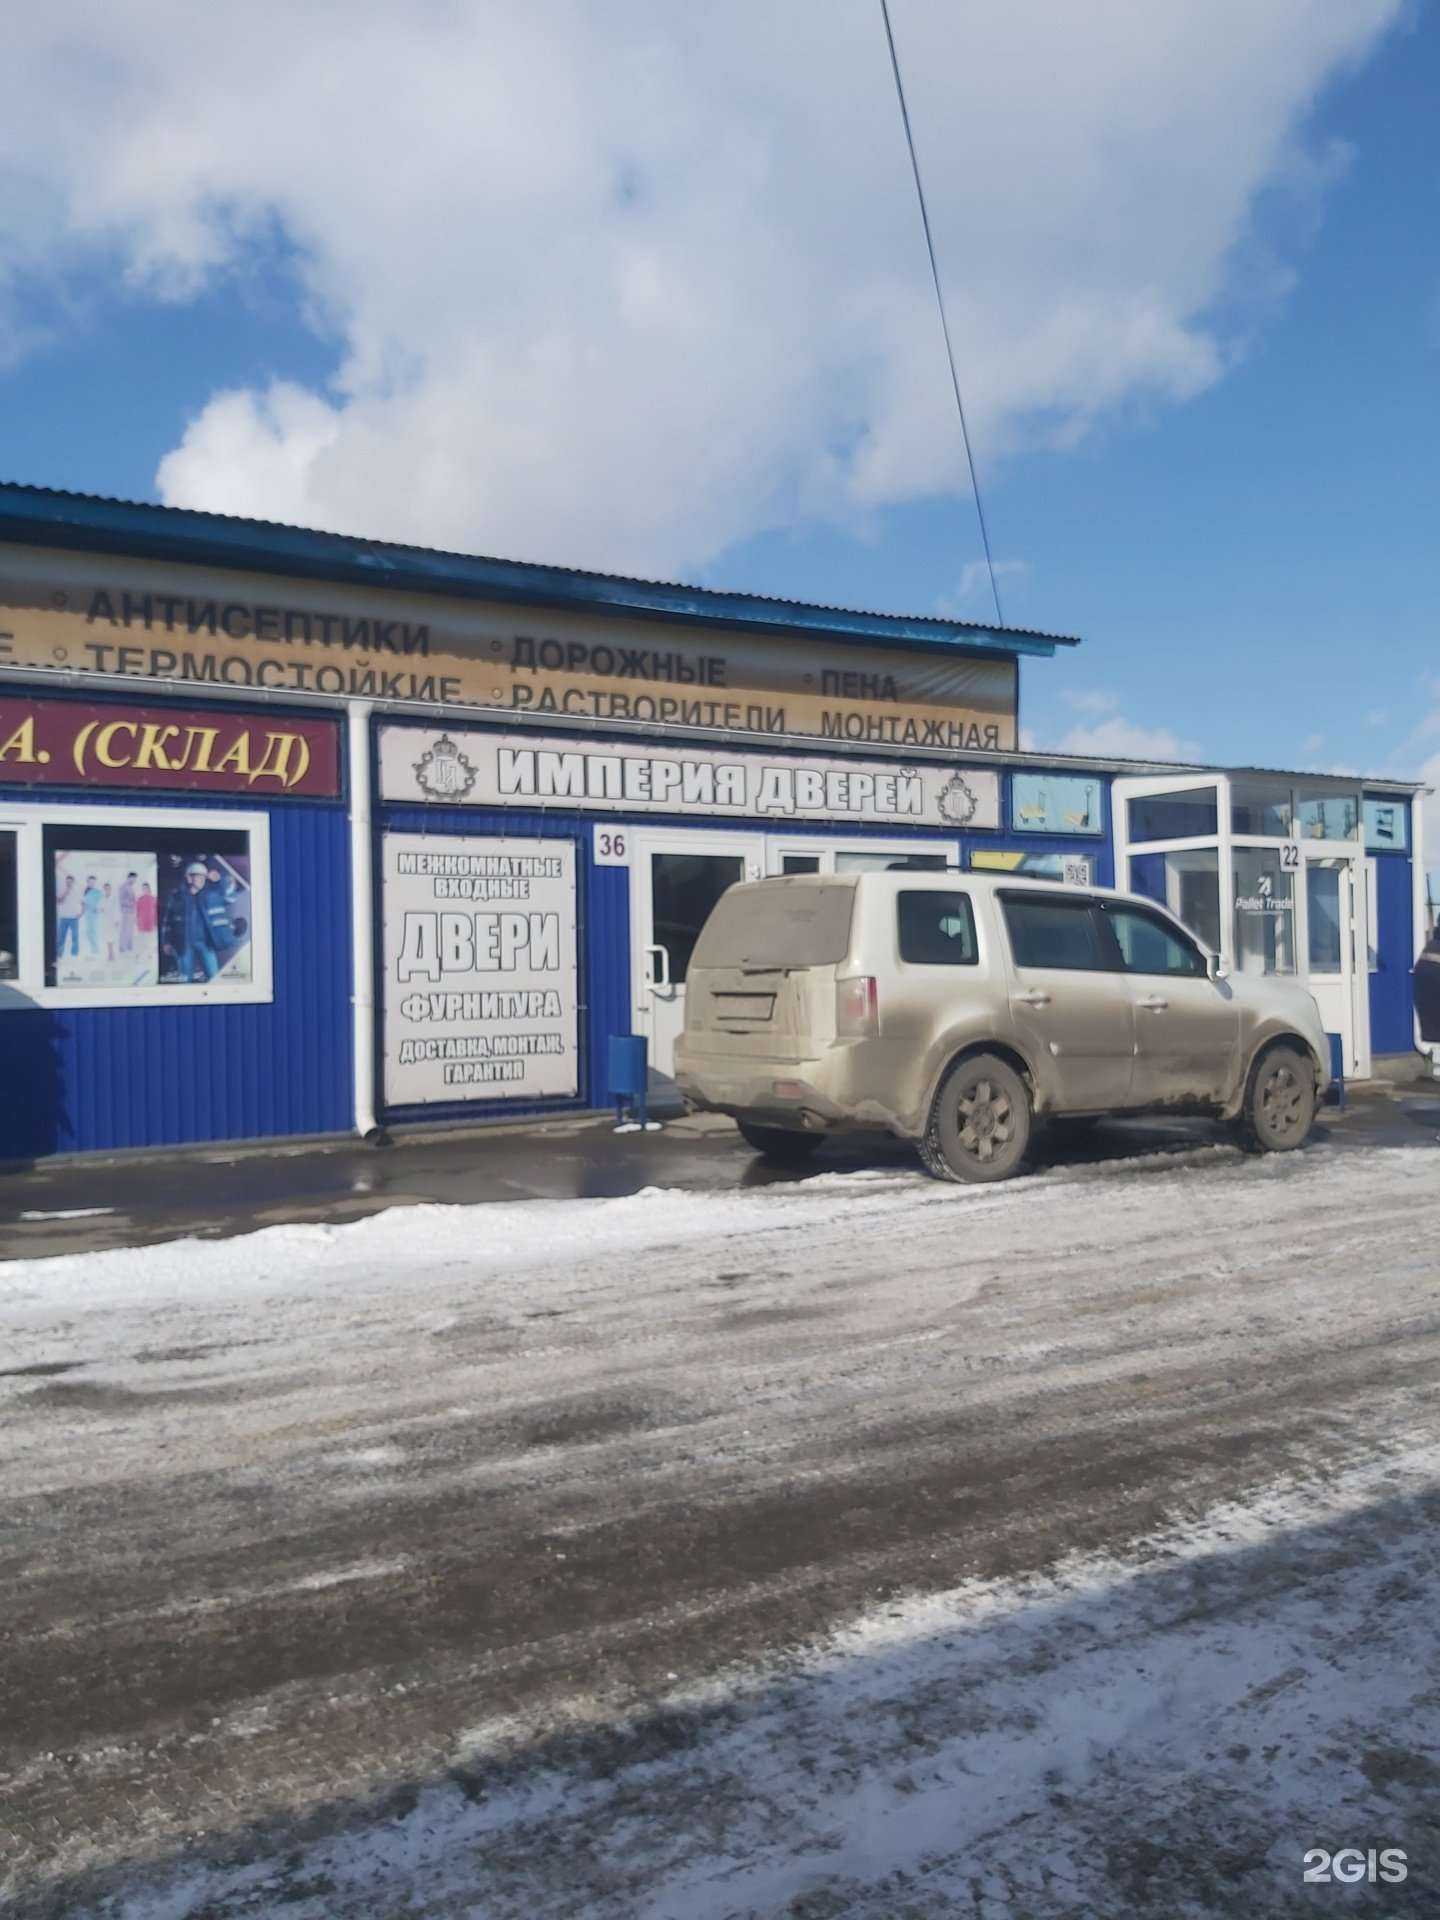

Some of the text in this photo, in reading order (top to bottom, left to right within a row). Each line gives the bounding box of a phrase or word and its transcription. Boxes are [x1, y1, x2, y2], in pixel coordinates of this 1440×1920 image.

[85, 588, 430, 657] АНТИСЕПТИКИ
[85, 644, 461, 702] ТЕРМОСТОЙКИЕ
[510, 637, 727, 687] ДОРОЖНЫЕ
[820, 669, 899, 702] ПЕНА
[820, 711, 999, 750] МОНТАЖНАЯ
[73, 720, 310, 787] (СКЛАД)
[497, 748, 923, 815] ИМПЕРИЯ ДВЕРЕЙ
[600, 834, 625, 857] 36
[1283, 845, 1299, 866] 22
[398, 852, 562, 878] МЕЖКОМНАТНЫЕ
[434, 877, 530, 901] ВХОДНЫЕ
[397, 911, 560, 983] ДВЕРИ
[400, 990, 562, 1022] ФУРНИТУРА
[444, 1059, 525, 1085] ГАРАНТИЯ
